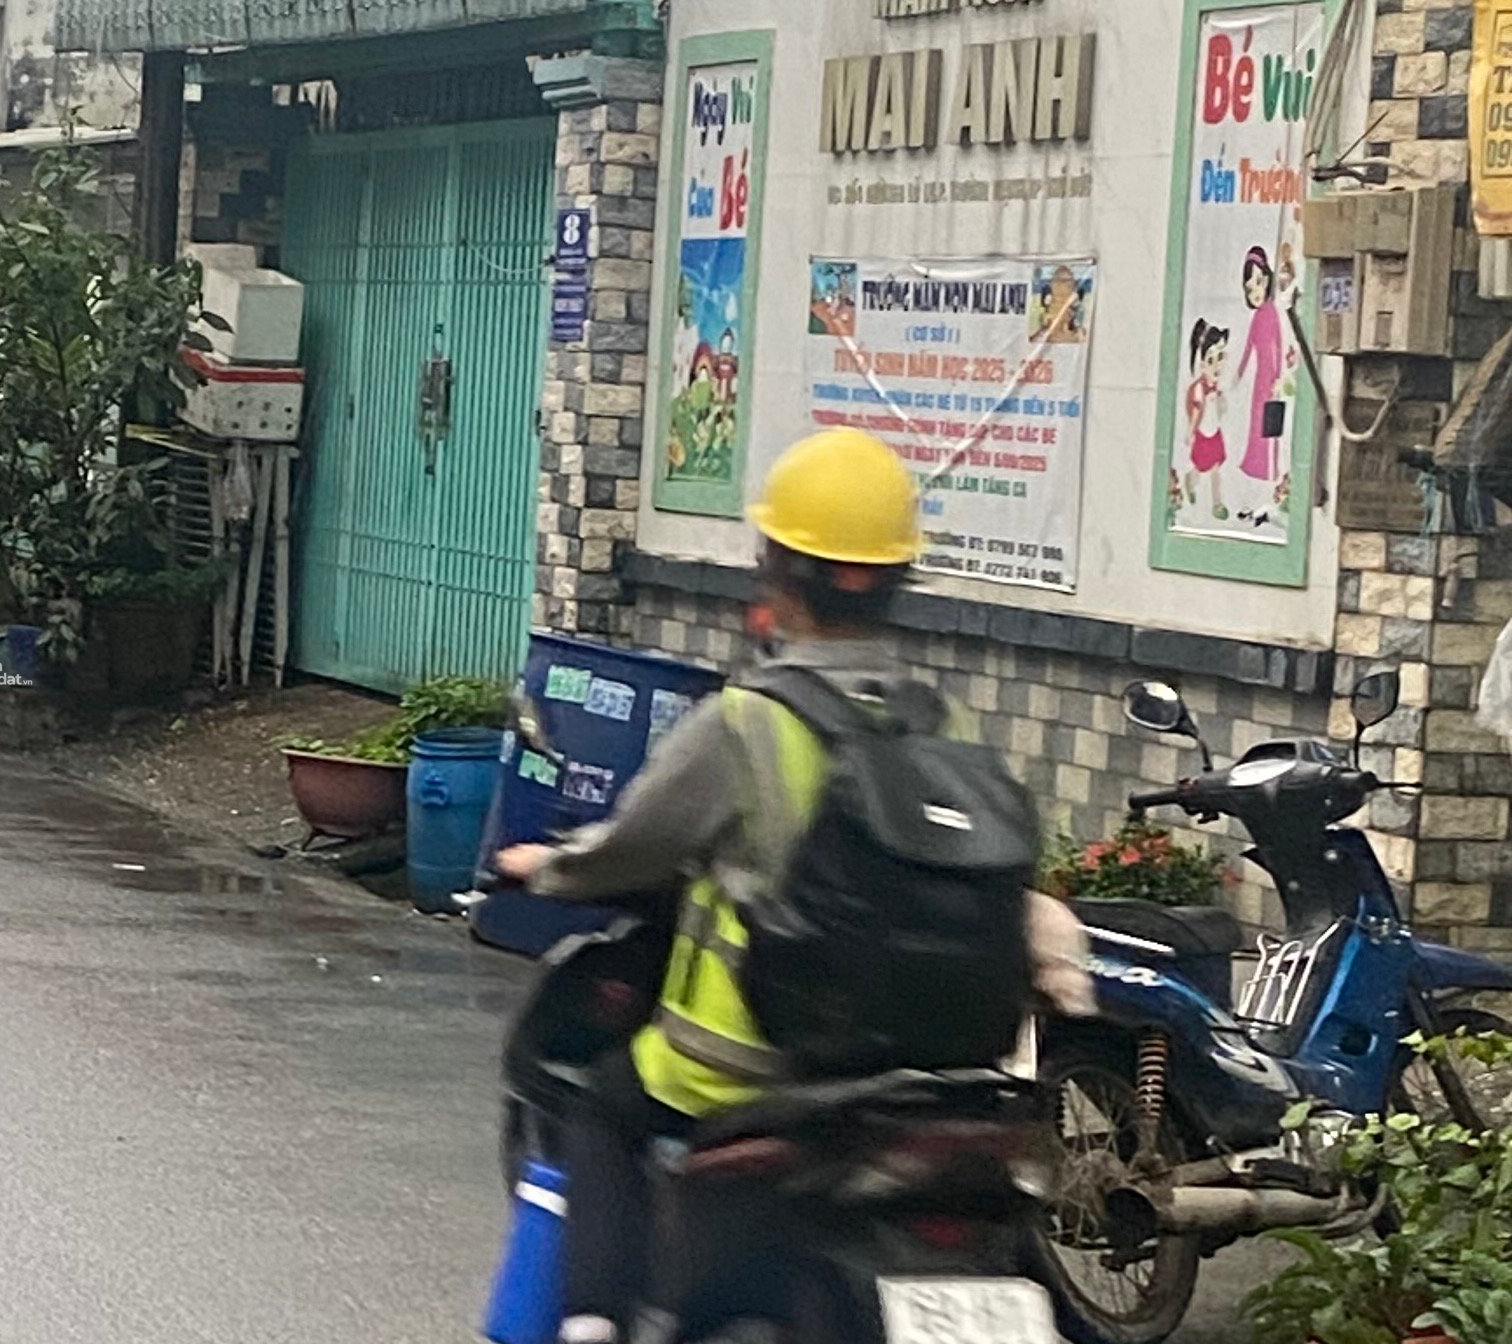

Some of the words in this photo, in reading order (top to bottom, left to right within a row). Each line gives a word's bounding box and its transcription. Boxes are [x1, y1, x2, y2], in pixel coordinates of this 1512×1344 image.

[819, 47, 943, 154] MAI
[943, 32, 1097, 147] ANH
[1202, 25, 1255, 125] Bé
[1262, 47, 1316, 123] Vui
[719, 147, 748, 231] Bé
[1200, 142, 1236, 204] Đến
